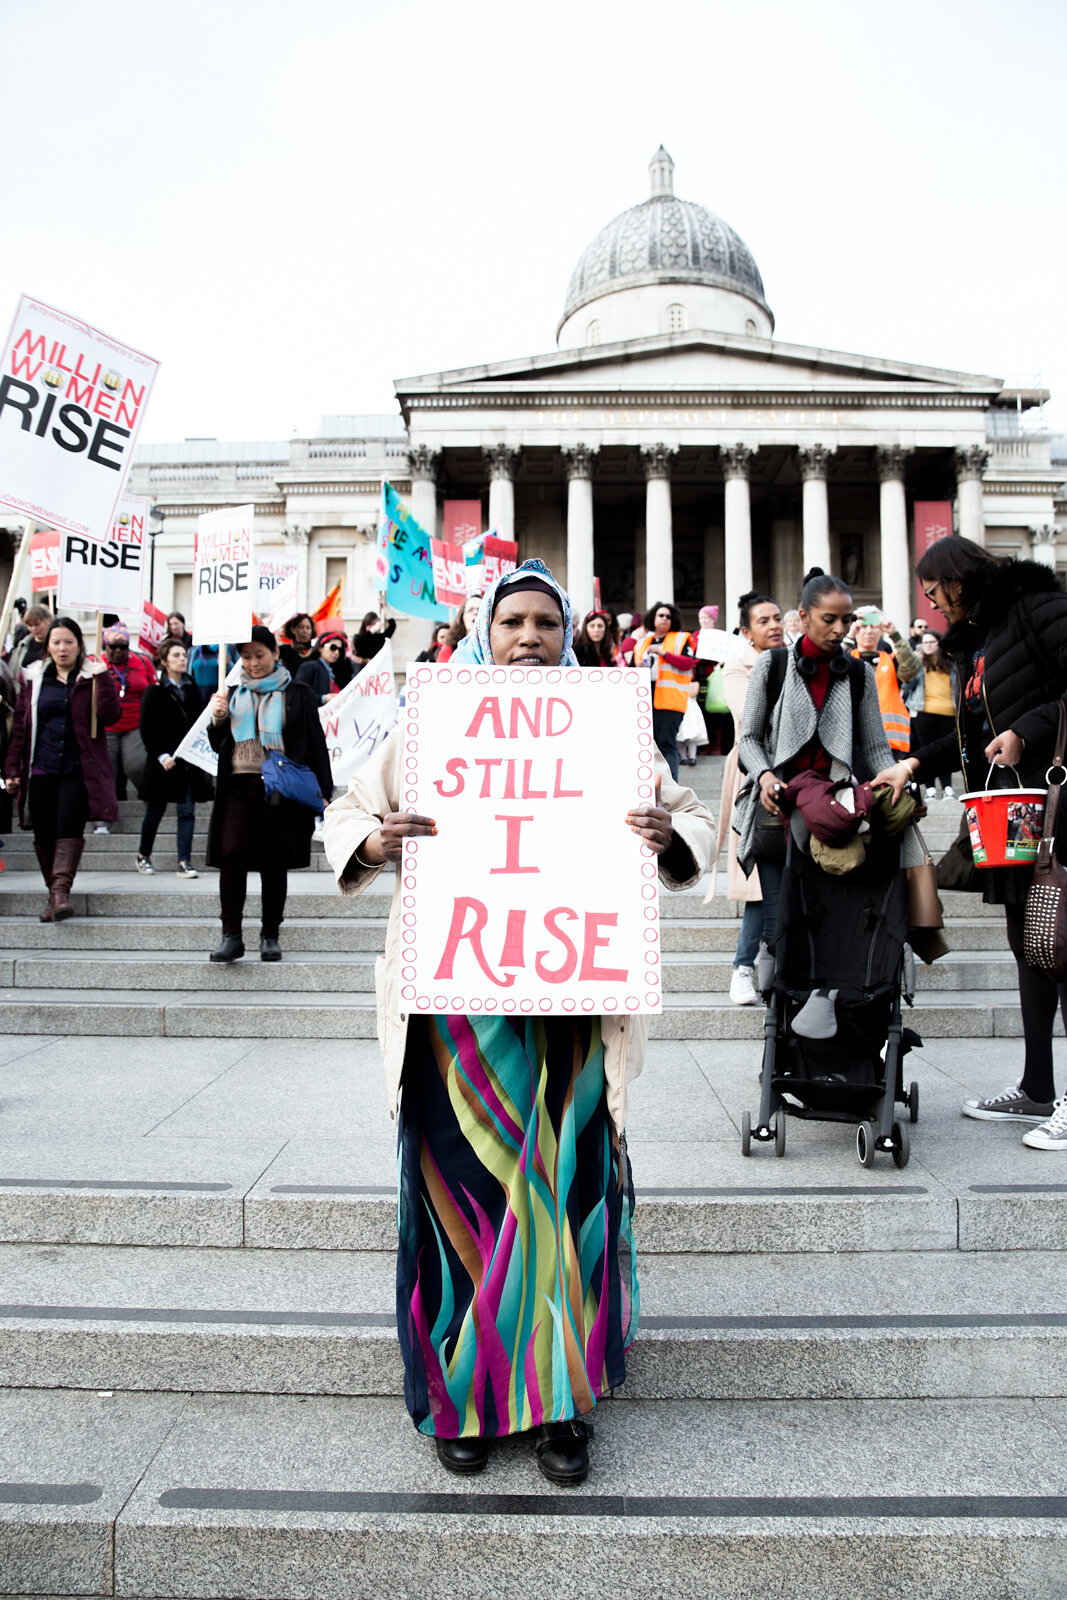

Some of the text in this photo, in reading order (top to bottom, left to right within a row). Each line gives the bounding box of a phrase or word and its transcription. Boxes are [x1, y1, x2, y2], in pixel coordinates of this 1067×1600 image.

[14, 328, 146, 407] MILLION
[11, 350, 138, 429] WOMEN
[0, 375, 131, 472] RISE
[535, 411, 584, 425] THE
[600, 411, 729, 425] NATIONAL
[65, 536, 142, 571] RISE
[200, 545, 250, 565] WOMEN
[201, 528, 250, 550] MILLION
[199, 561, 249, 596] RISE
[465, 696, 573, 738] AND
[433, 757, 583, 799] STILL
[490, 814, 541, 874] I
[434, 896, 629, 988] RISE
